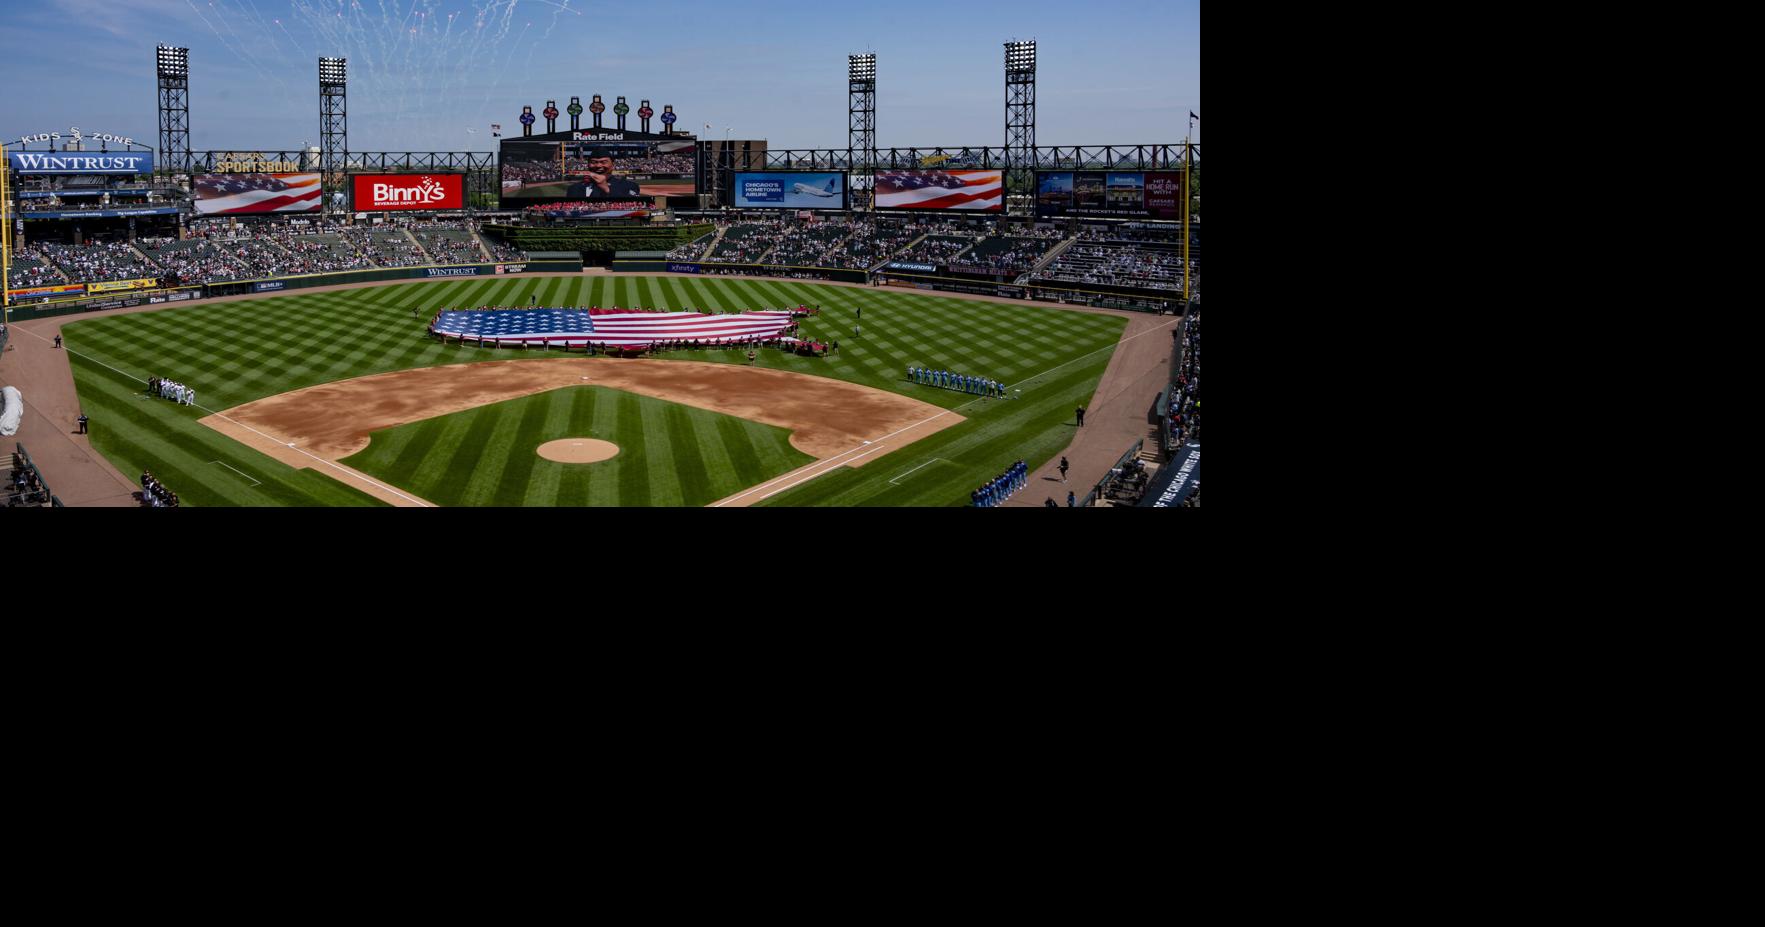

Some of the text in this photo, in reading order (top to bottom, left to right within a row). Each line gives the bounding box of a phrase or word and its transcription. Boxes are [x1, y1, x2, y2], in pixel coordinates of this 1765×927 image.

[21, 131, 133, 145] KIDS ZONE
[573, 132, 624, 141] Rate Field
[216, 161, 299, 173] SPORTSBOOK
